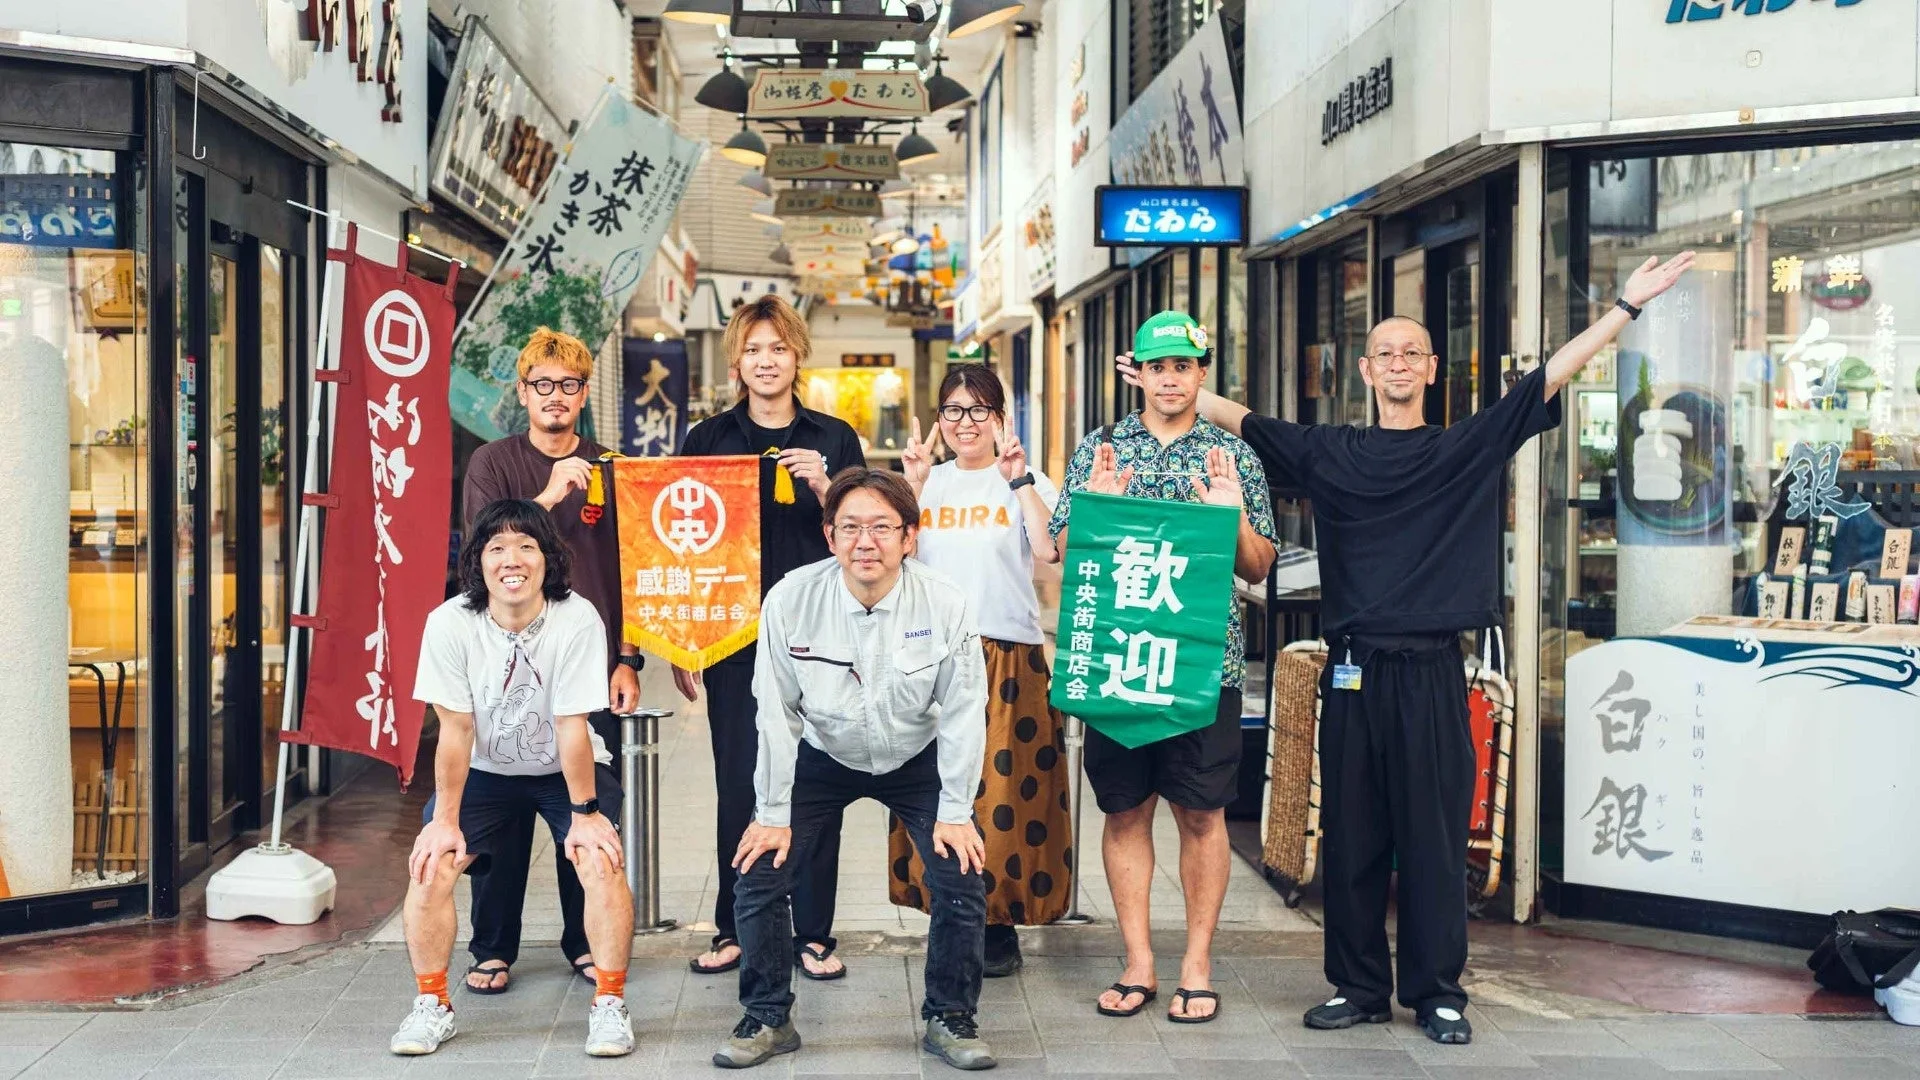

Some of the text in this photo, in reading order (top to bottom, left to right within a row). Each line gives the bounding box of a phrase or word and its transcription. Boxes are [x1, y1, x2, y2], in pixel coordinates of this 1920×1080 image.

[852, 82, 916, 99] たわら
[1321, 57, 1393, 147] 山口県名産品
[521, 169, 602, 275] かき氷
[588, 150, 655, 237] 抹茶
[1123, 206, 1217, 233] たわら
[1140, 198, 1200, 207] 山口県名産品
[1771, 254, 1863, 294] 蒲鉾
[633, 358, 678, 458] 大判
[1772, 316, 1872, 520] 白銀
[919, 506, 1010, 529] ABIRA
[1886, 539, 1900, 571] 白銀
[635, 566, 747, 597] 感謝デー
[638, 603, 747, 621] 中央街商店会
[1100, 535, 1189, 706] 歓迎
[904, 628, 932, 638] SANSEI
[1066, 559, 1101, 701] 中央街商店会
[1580, 670, 1673, 863] 白銀
[1655, 713, 1668, 831] ハクギン
[1691, 680, 1705, 873] 美し国の、旨し逸品。
